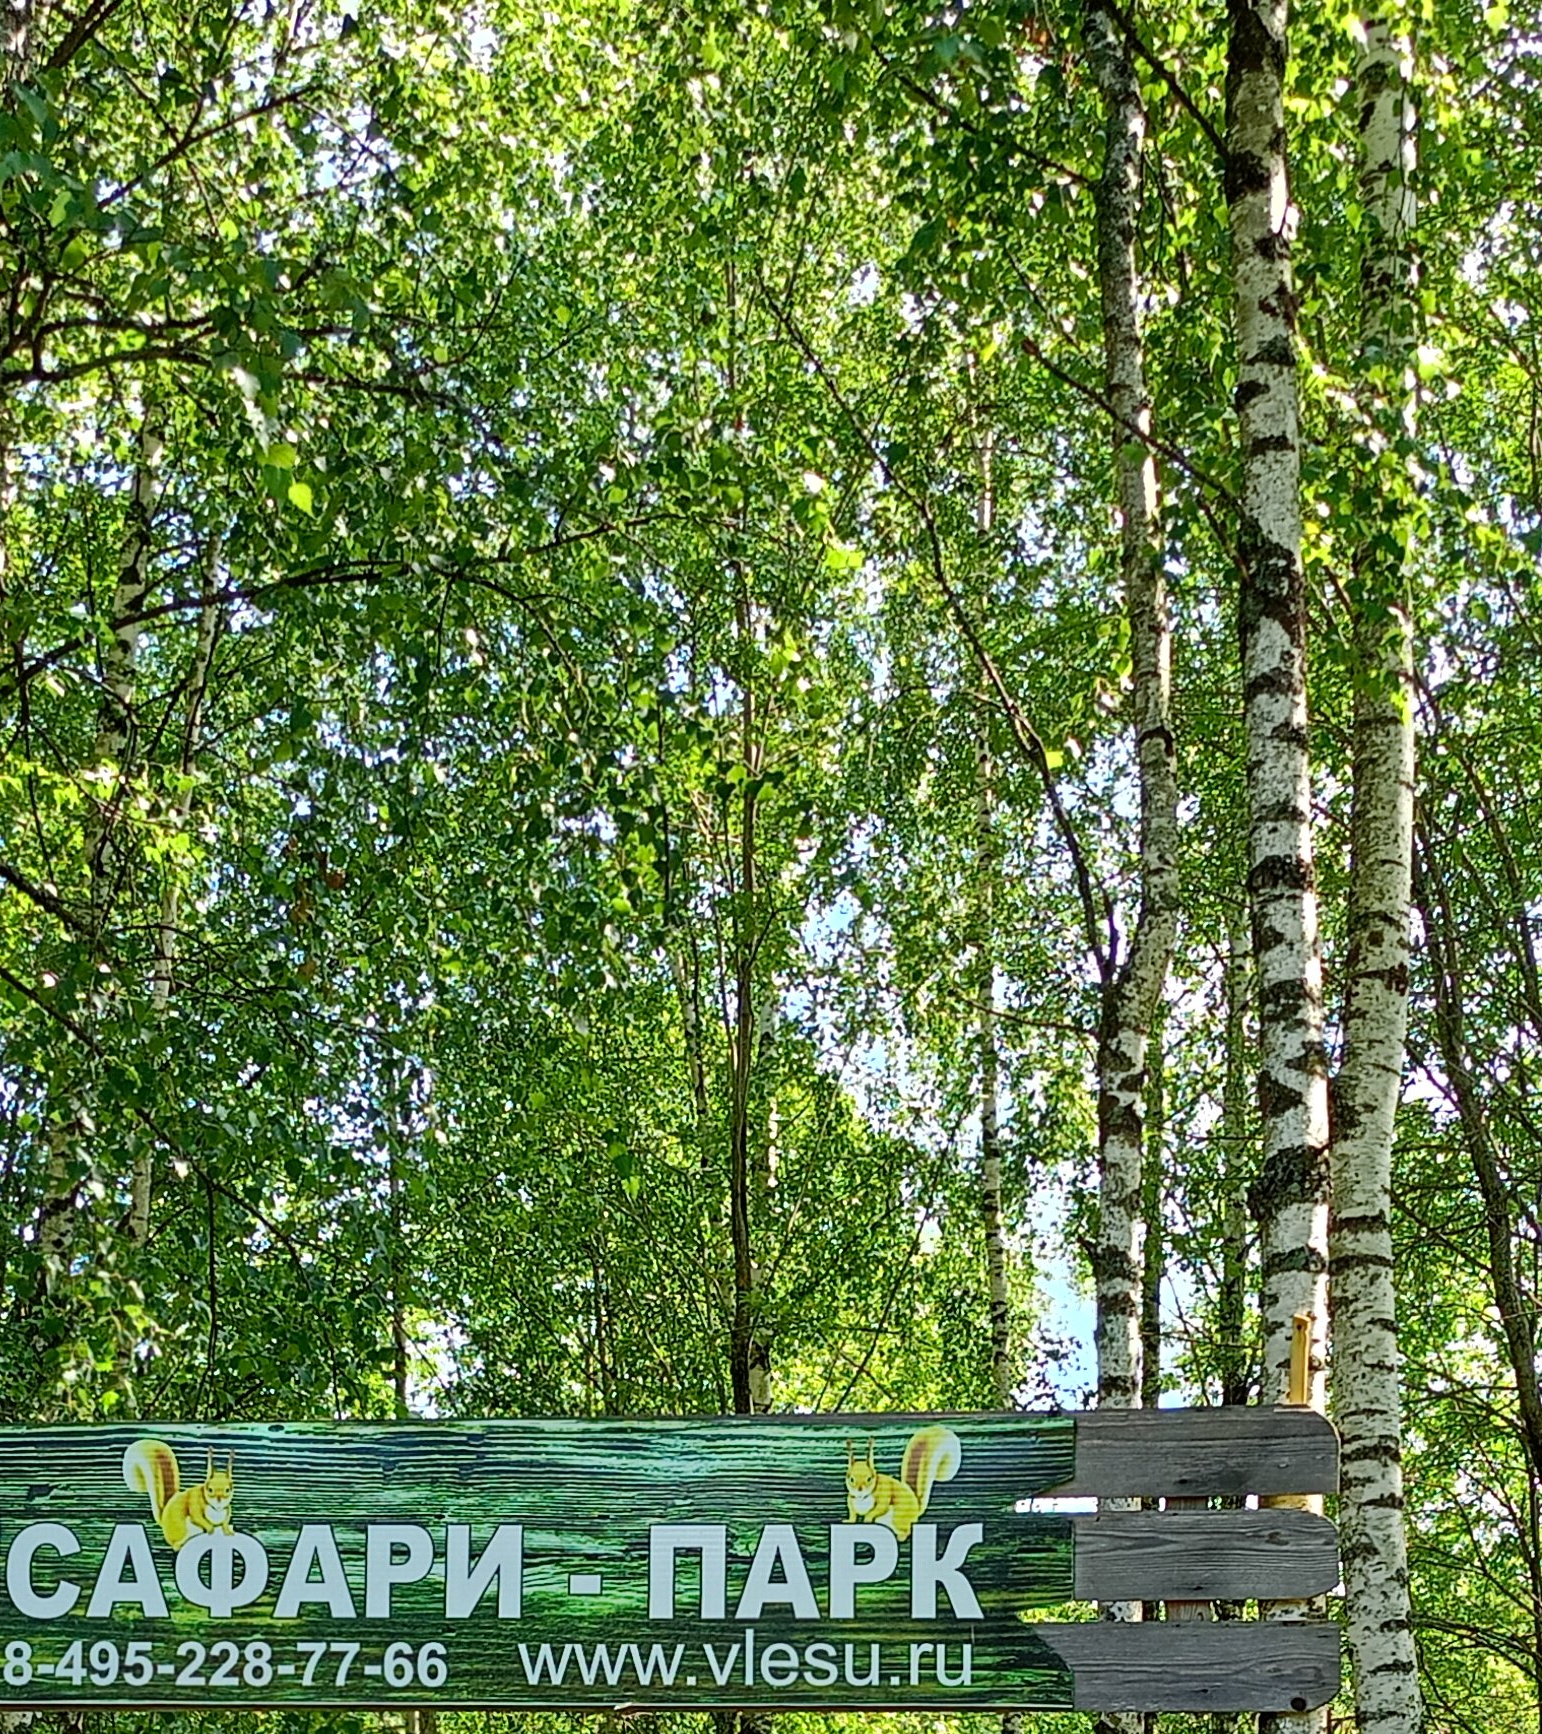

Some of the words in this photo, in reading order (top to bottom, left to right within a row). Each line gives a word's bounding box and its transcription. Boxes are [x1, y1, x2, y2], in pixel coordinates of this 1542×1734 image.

[5, 1521, 524, 1620] САФАРИ
[568, 1573, 603, 1596] -
[648, 1522, 985, 1620] ПАРК
[2, 1640, 449, 1688] 8-495-228-77-66
[517, 1627, 974, 1688] www.vlesu.ru
